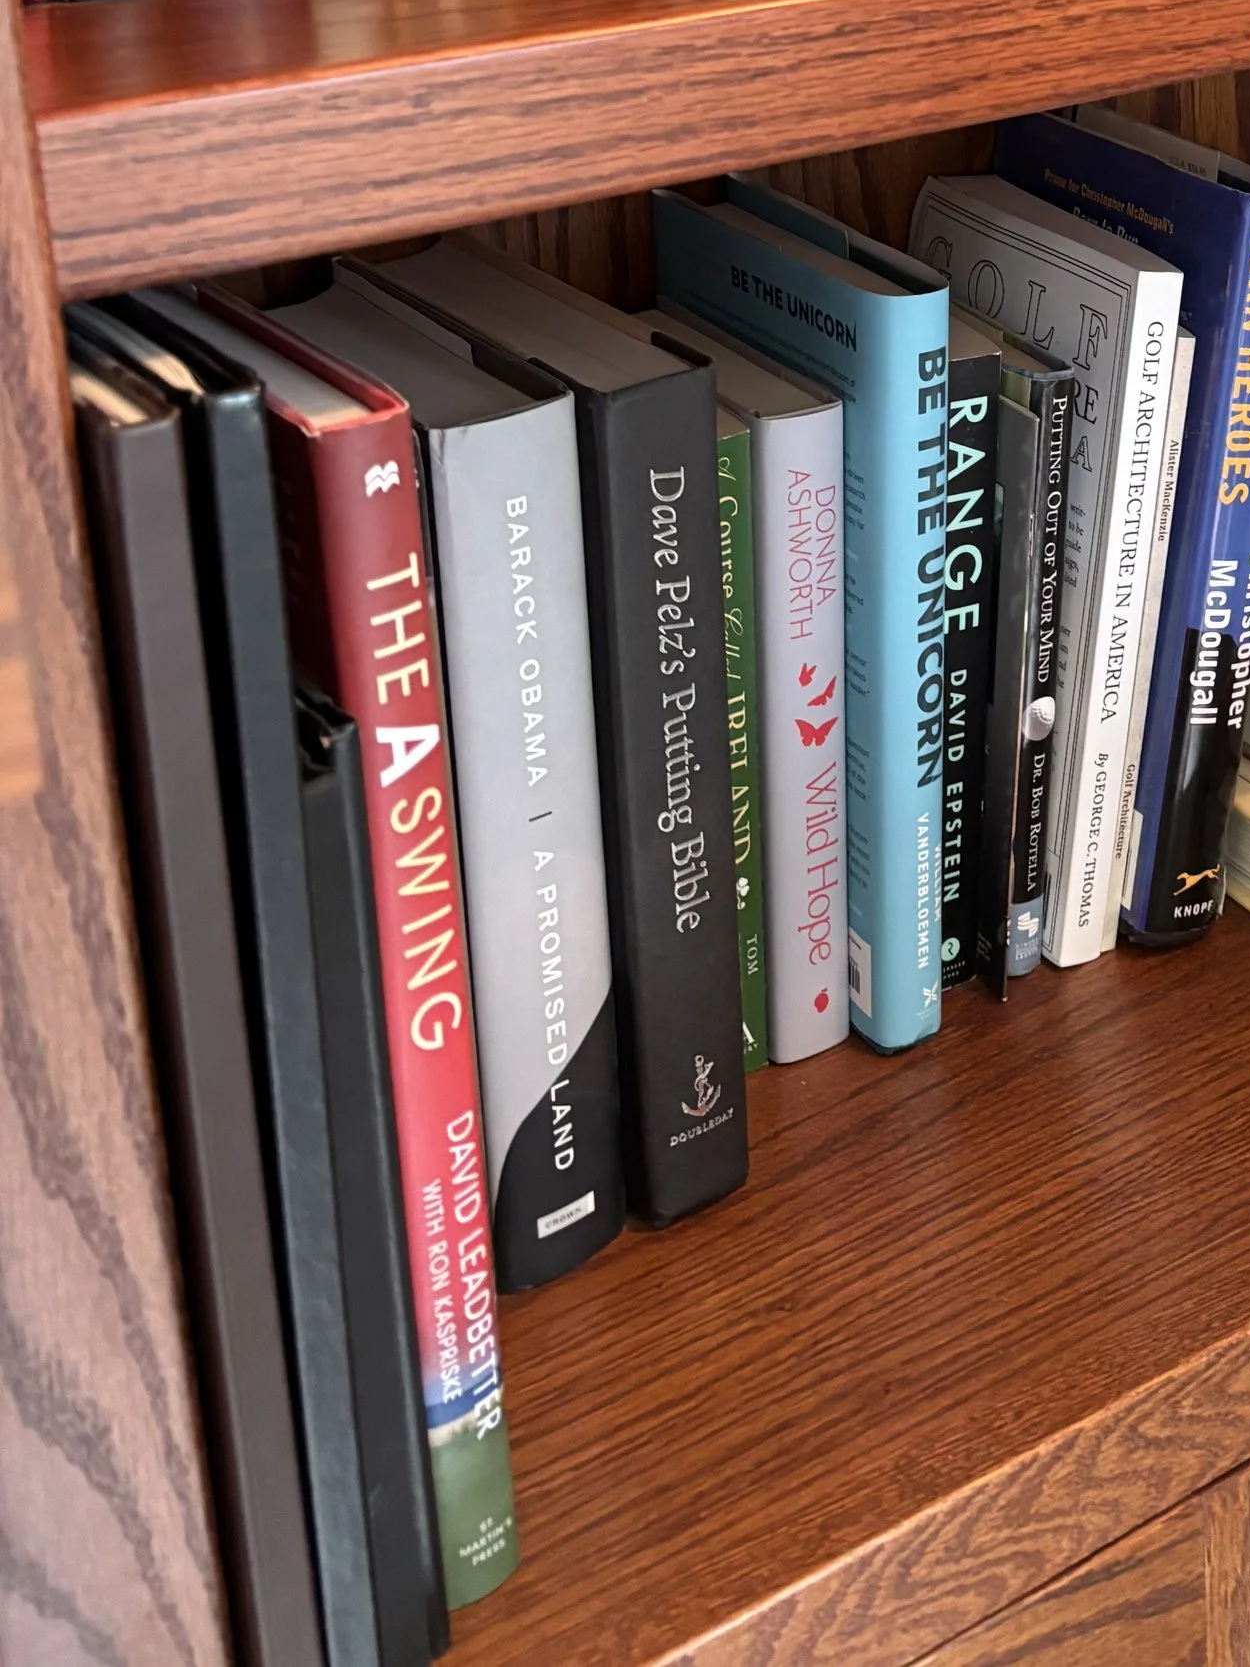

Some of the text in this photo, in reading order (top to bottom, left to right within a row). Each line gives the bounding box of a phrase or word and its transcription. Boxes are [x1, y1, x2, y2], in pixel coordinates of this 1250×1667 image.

[730, 265, 858, 352] BE THE UNICORN
[787, 469, 814, 640] ASHWORTH
[815, 484, 837, 606] DONNA
[916, 345, 947, 789] BE THE UNICORN
[944, 395, 989, 635] RANGE
[1101, 321, 1165, 723] GOLF ARCHITECTURE IN AMERICA
[1158, 439, 1179, 542] Alister MacKenzie
[649, 465, 711, 934] Dave Pelz's Putting Bible
[1189, 558, 1238, 727] McDougall
[366, 552, 461, 1050] THE A SWING
[506, 495, 575, 1171] BARACK OBAMA A PROMISED LAND
[798, 761, 838, 966] Wild Hope
[943, 668, 967, 904] DAVID EPSTEIN
[1078, 752, 1108, 928] By GEORGE C. THOMAS
[1115, 764, 1136, 860] Golf Architecture
[917, 812, 929, 969] VANDERBLOEMEN
[1173, 899, 1214, 919] KNOPF
[422, 1178, 463, 1404] WITH RON KASPRISKE
[447, 1111, 503, 1441] DAVID LEADBETTER
